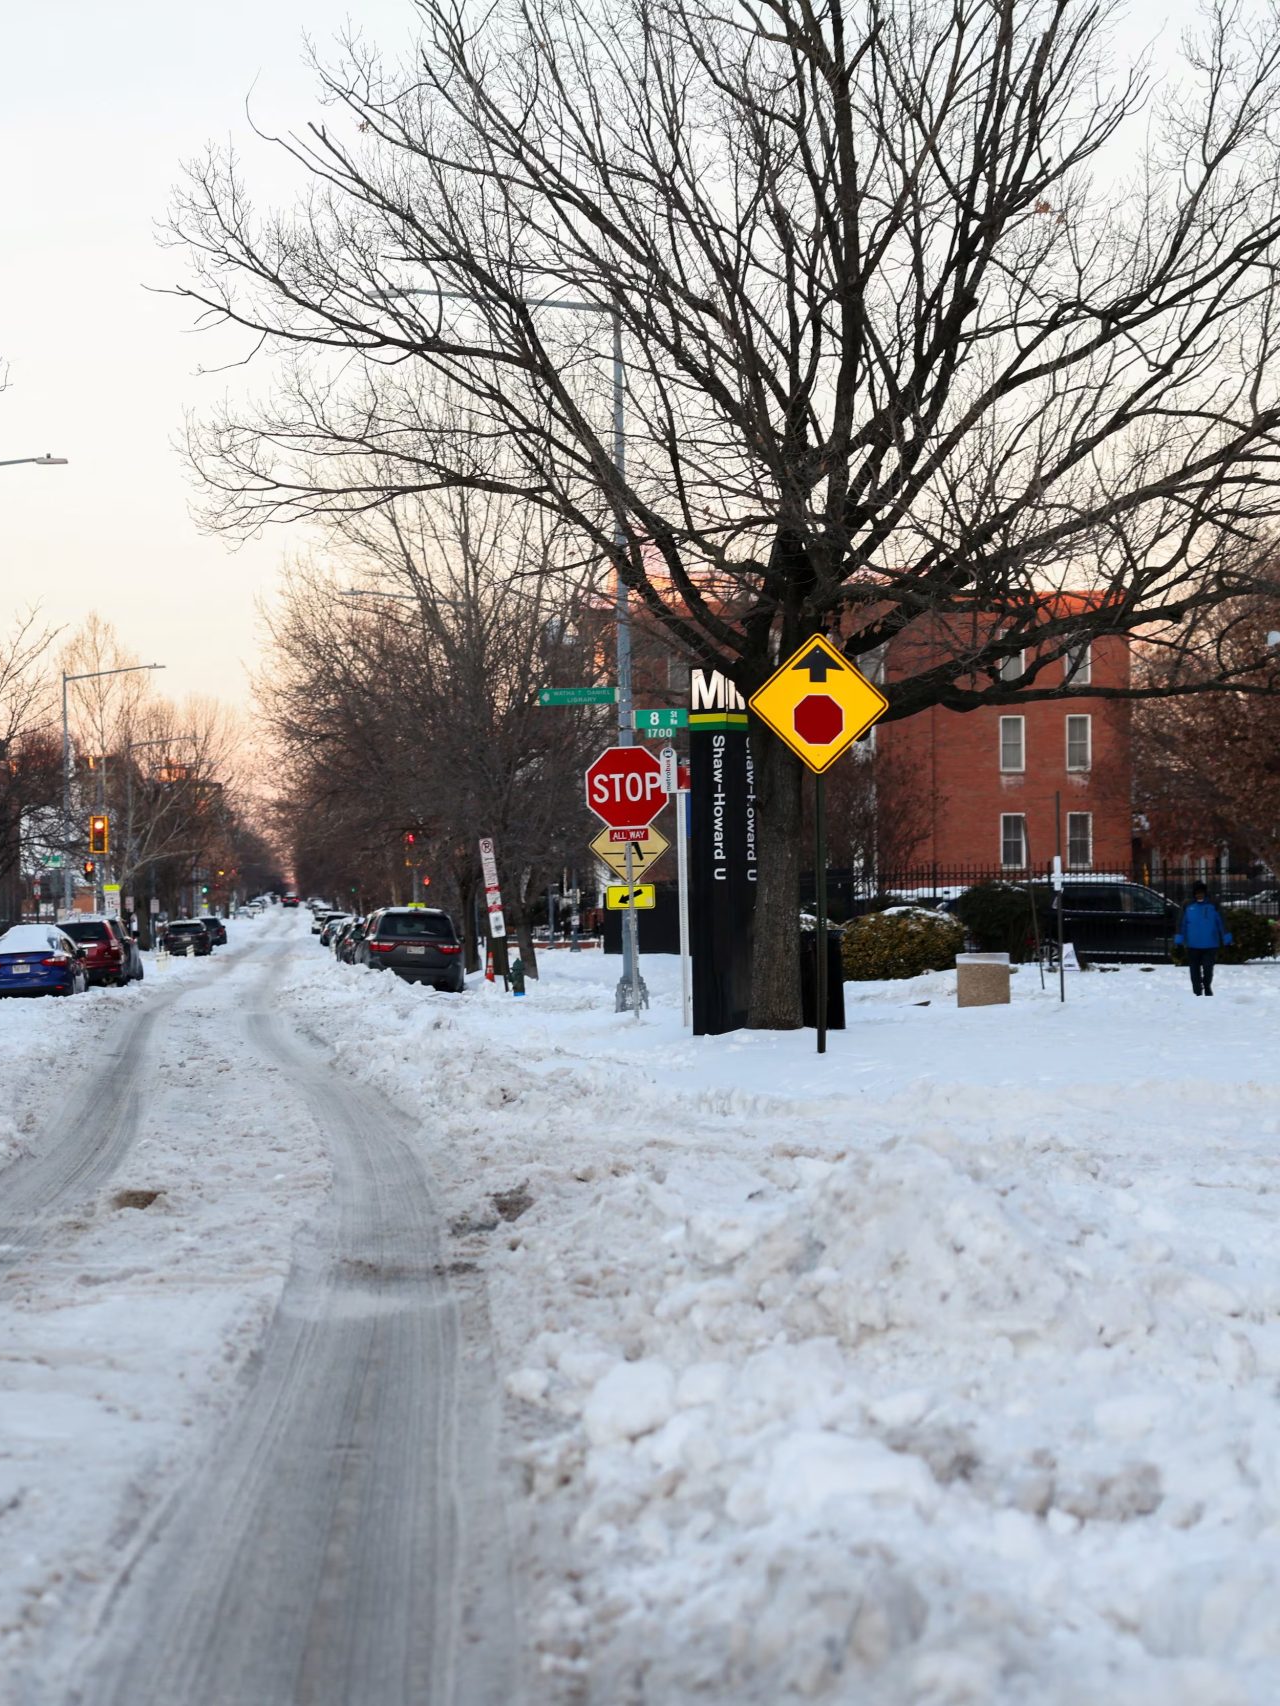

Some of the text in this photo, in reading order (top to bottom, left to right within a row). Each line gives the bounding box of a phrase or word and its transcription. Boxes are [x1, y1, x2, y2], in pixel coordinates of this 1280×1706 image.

[650, 711, 660, 726] 8
[648, 728, 673, 738] 1700
[593, 771, 661, 803] STOP
[712, 735, 726, 881] Shaw-Howard U
[612, 830, 645, 840] ALL WAY
[747, 869, 757, 881] U
